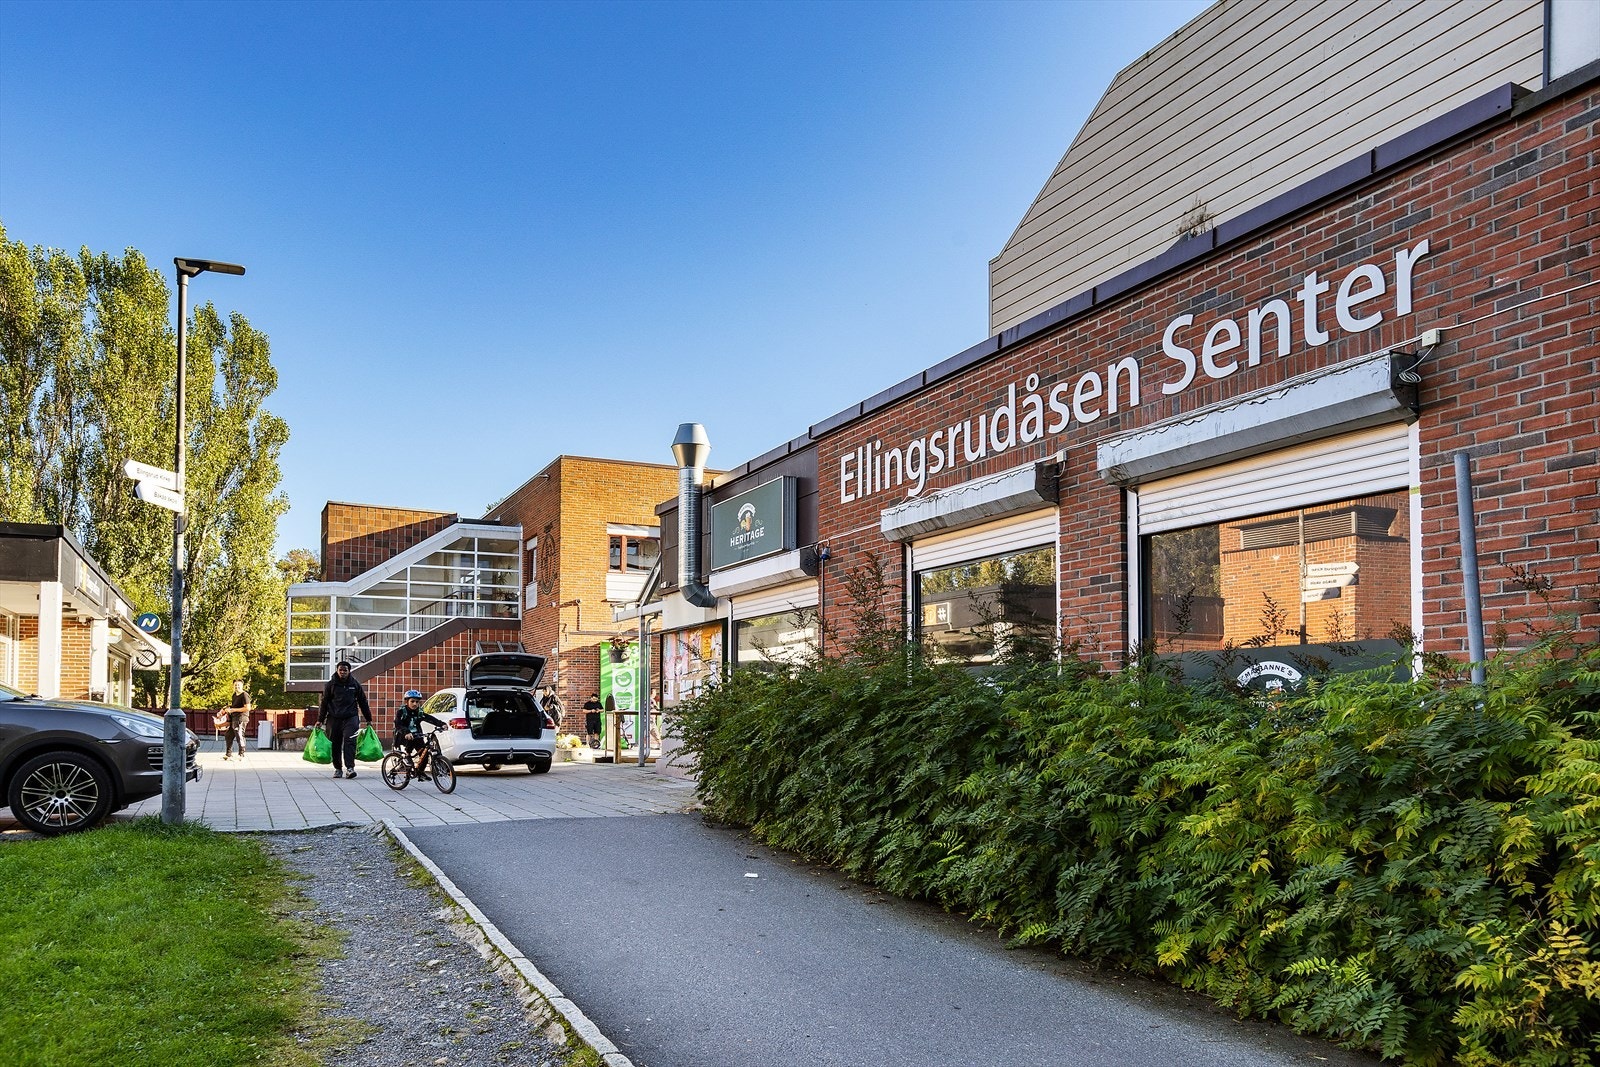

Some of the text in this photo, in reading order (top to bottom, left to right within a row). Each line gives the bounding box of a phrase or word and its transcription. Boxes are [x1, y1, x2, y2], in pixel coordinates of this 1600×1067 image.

[841, 239, 1430, 504] Ellingsrudåsen Senter
[730, 527, 765, 547] HERITAGE
